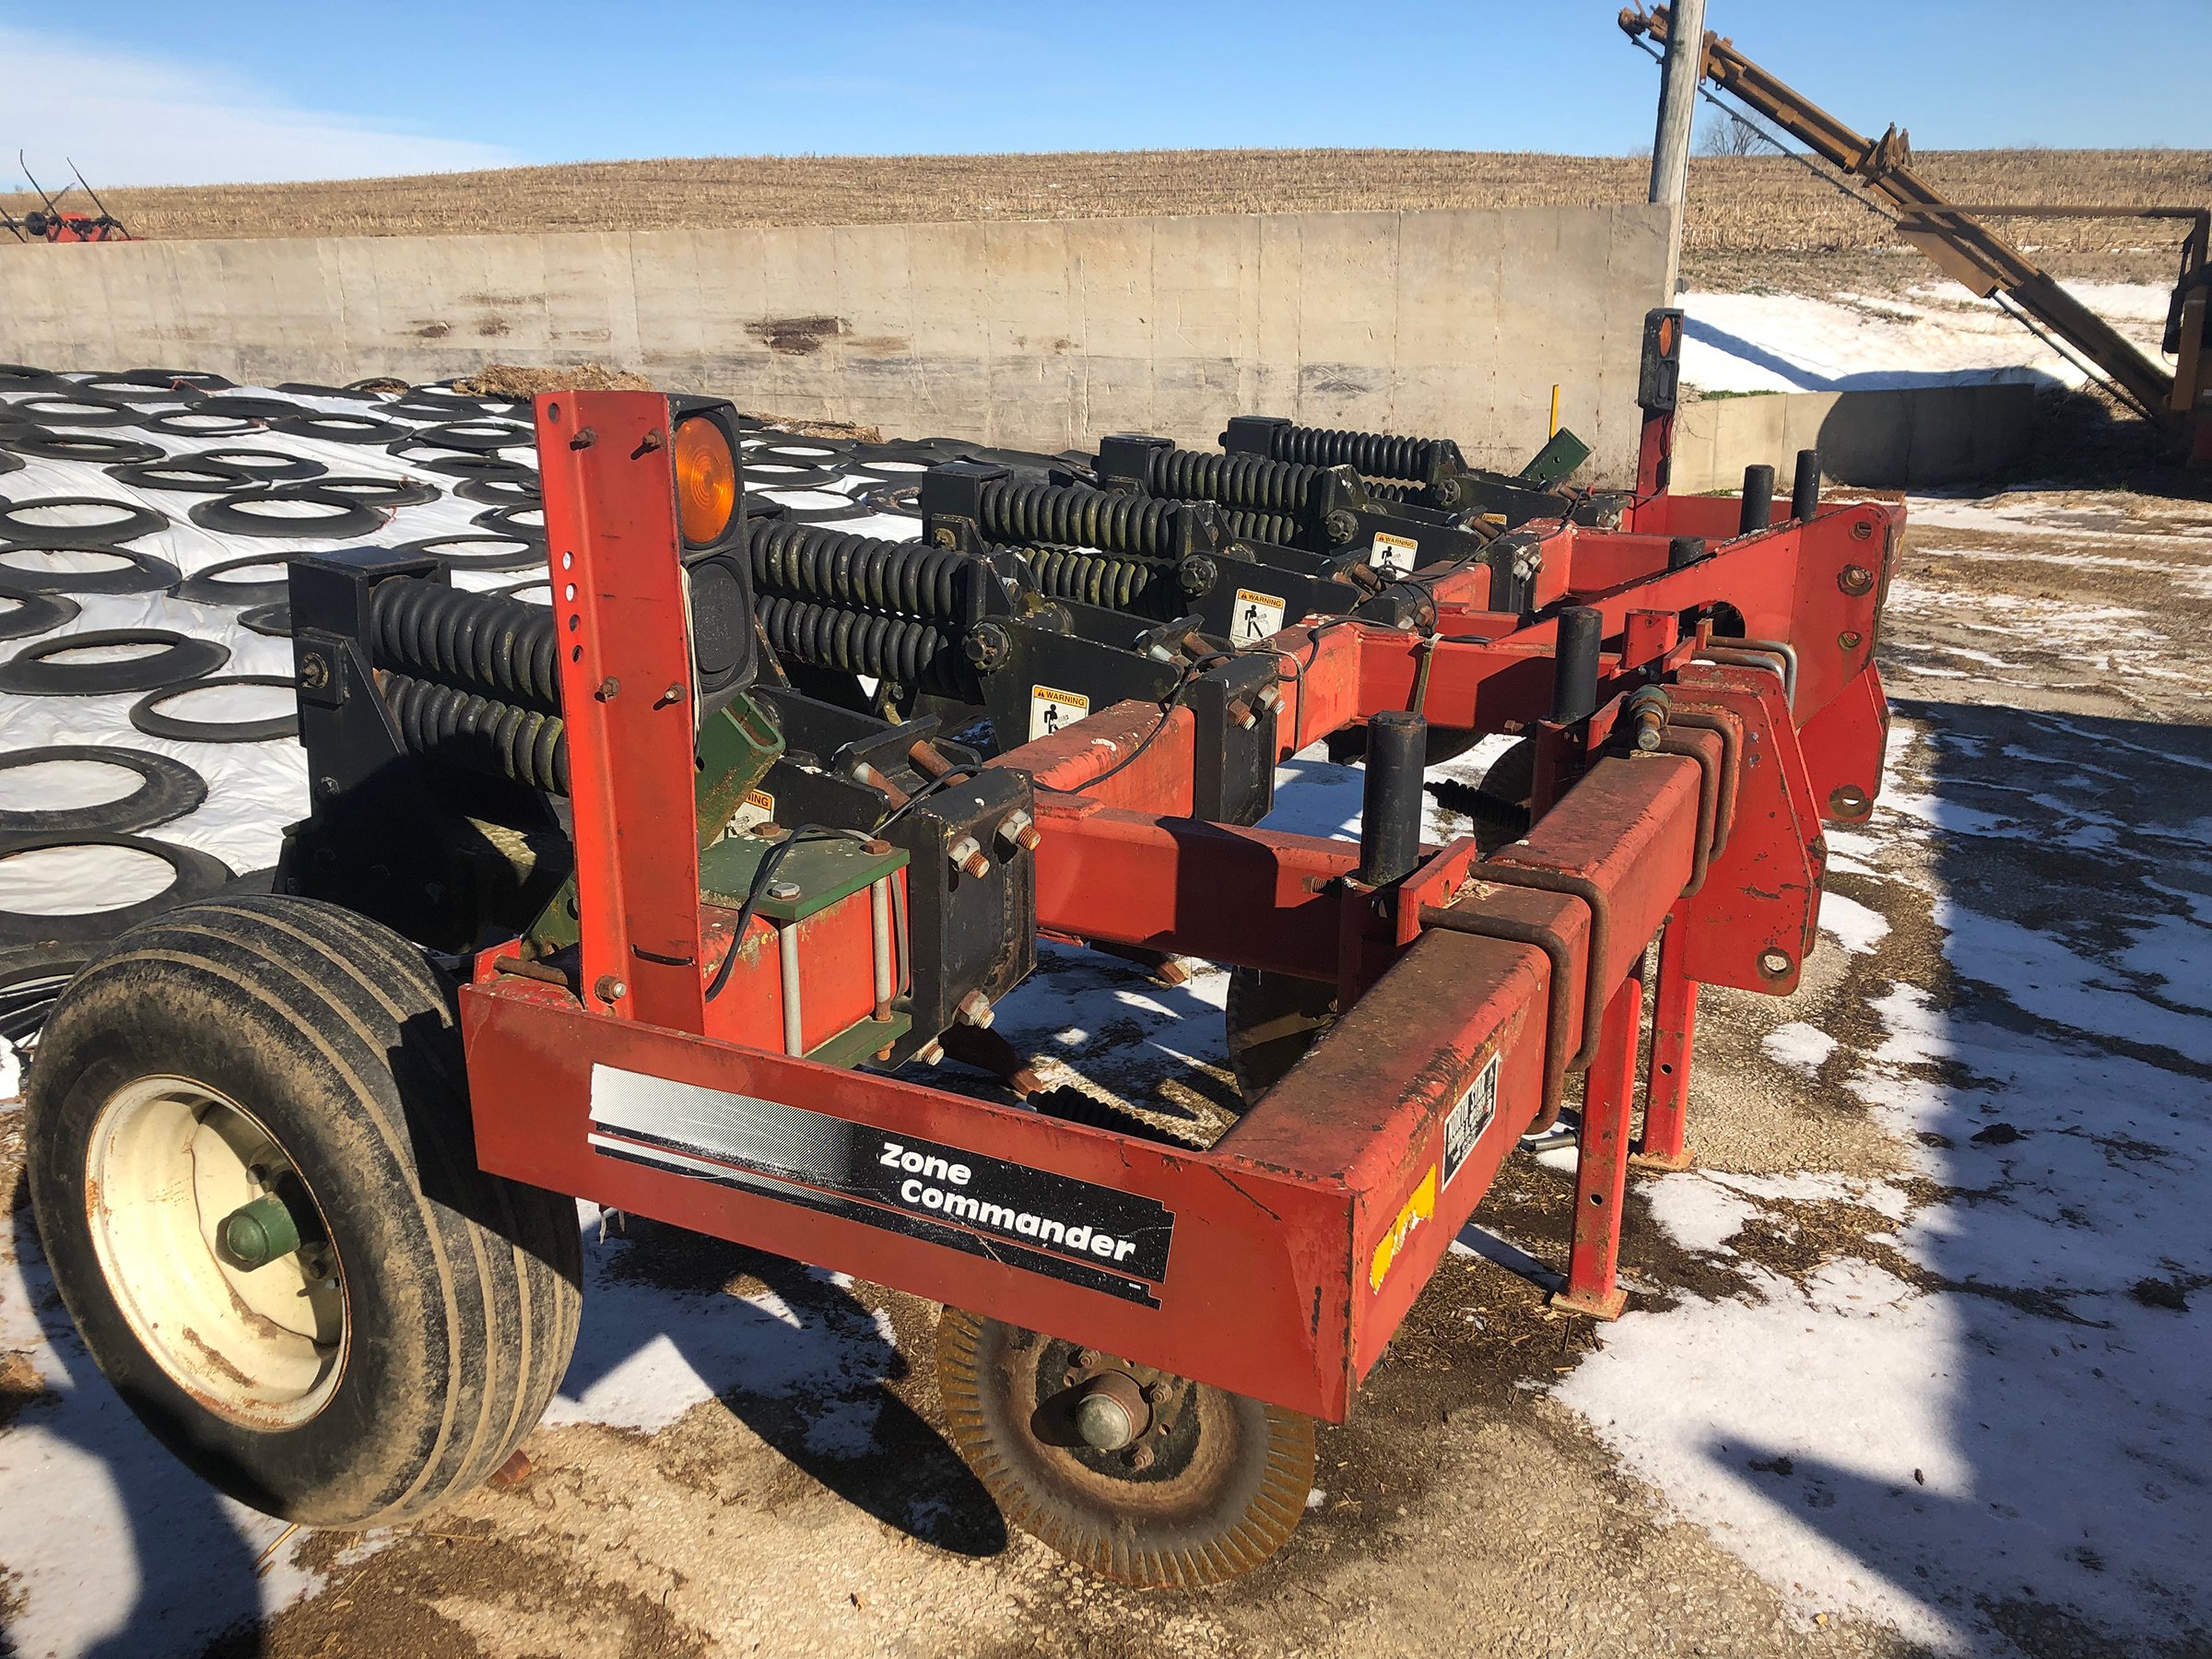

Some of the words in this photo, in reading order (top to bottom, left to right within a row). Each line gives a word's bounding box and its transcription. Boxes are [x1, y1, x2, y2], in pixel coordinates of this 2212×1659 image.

[1386, 536, 1414, 547] WARNING
[1248, 594, 1281, 607] WARNING
[1046, 690, 1085, 707] WARNING
[879, 1141, 972, 1185] Zone
[900, 1179, 1136, 1262] Commander
